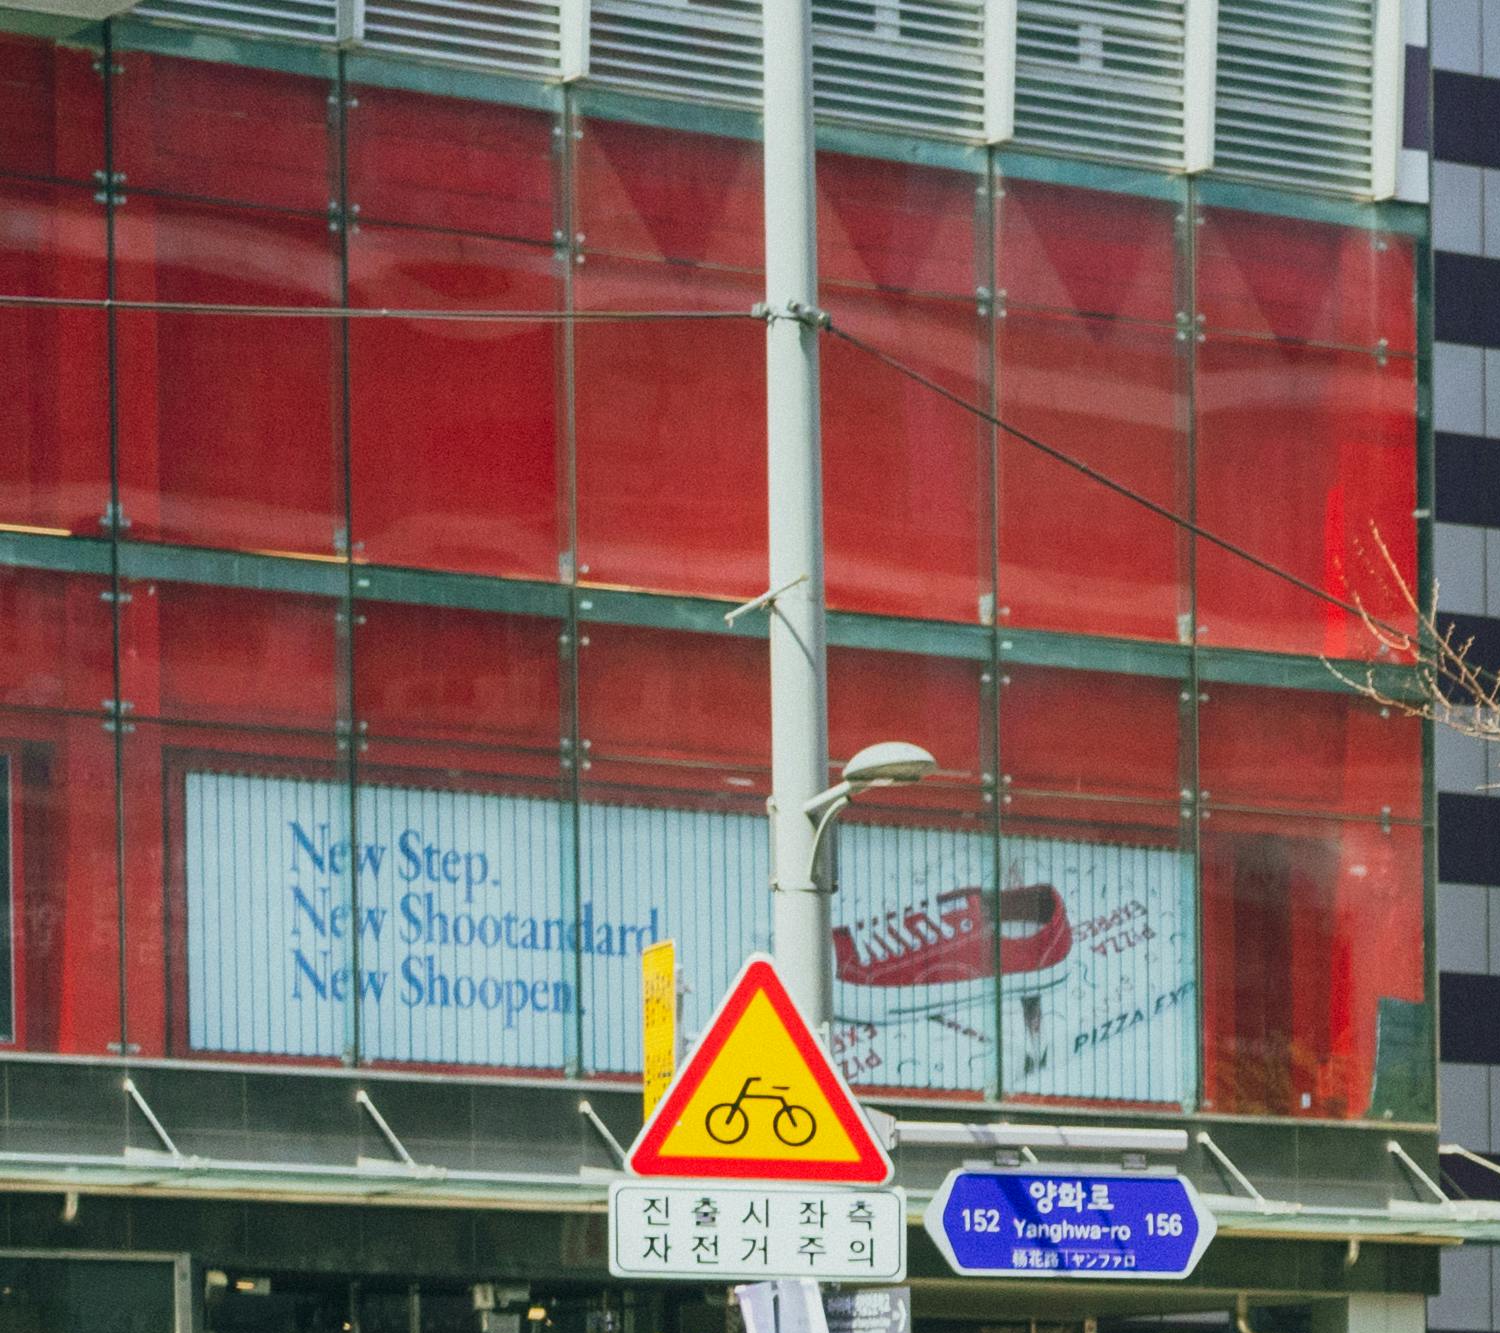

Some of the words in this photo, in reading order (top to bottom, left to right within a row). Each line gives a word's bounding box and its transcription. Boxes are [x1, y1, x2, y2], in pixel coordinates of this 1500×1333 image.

[288, 820, 388, 881] New
[397, 827, 501, 904] Step.
[288, 885, 389, 945] New
[399, 893, 661, 960] Shootandard
[289, 948, 389, 1006] New
[642, 1197, 772, 1229] 진출시
[797, 1198, 877, 1230] 좌측
[1029, 1179, 1115, 1215] 양화로
[961, 1208, 1001, 1234] 152
[1012, 1217, 1132, 1244] Yanghwa-ro
[1144, 1212, 1184, 1238] 156
[641, 1232, 772, 1267] 자전거
[796, 1234, 877, 1269] 주의
